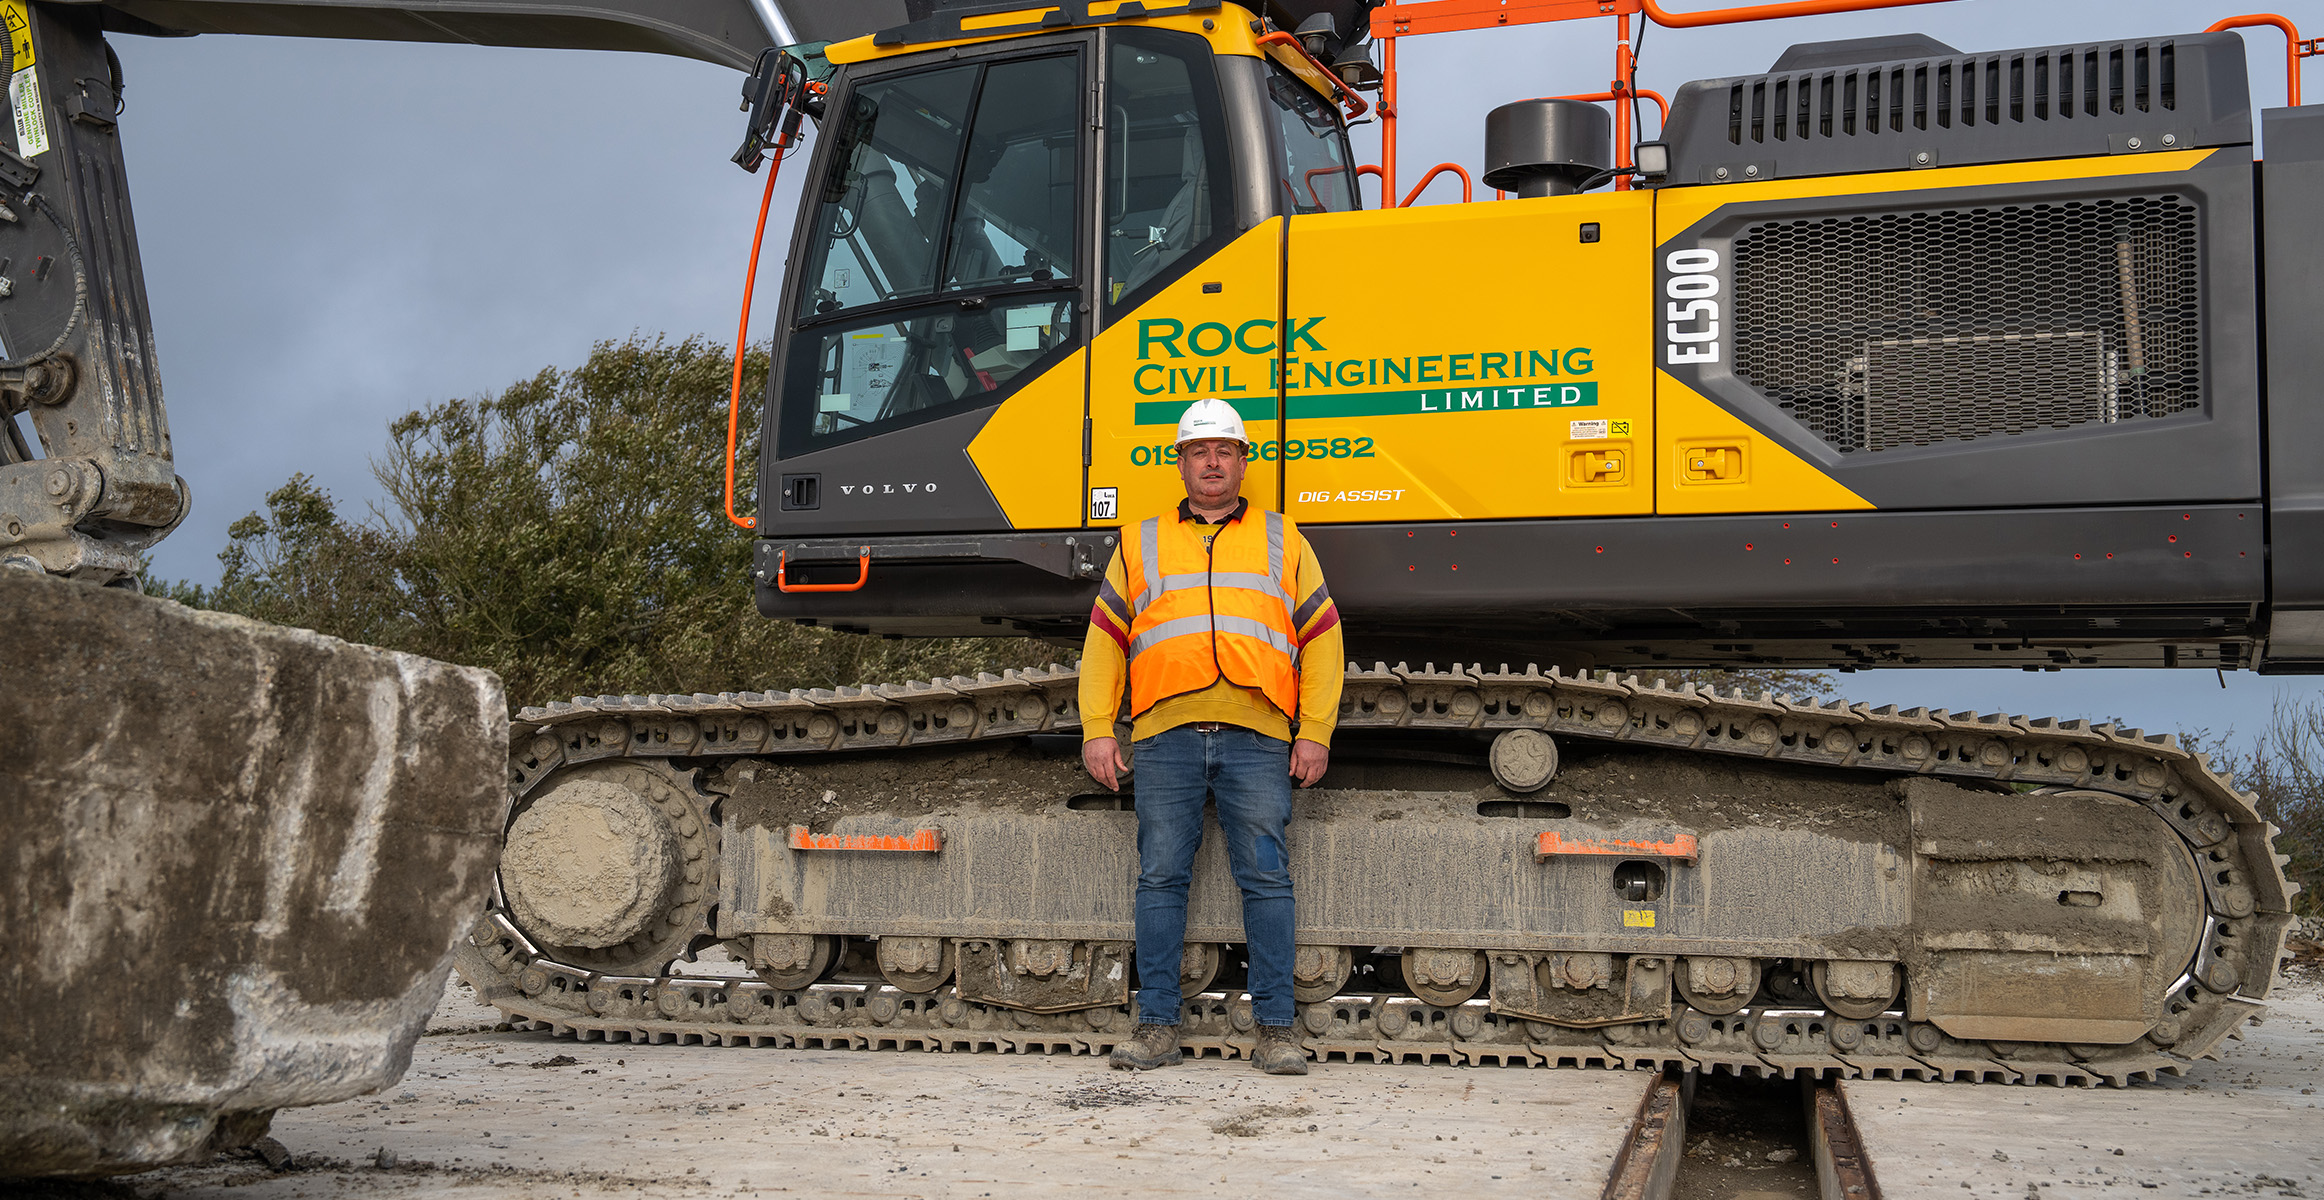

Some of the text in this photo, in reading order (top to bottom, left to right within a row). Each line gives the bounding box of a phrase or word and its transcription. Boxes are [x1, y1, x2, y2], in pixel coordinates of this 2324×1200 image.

[18, 83, 34, 145] GENUINE MILLER
[23, 73, 41, 149] TWINLOCK COUPLER
[1666, 248, 1719, 364] EC500
[1136, 316, 1328, 360] ROCK
[1133, 347, 1595, 396] CIVIL ENGINEERING
[1420, 386, 1582, 412] LIMITED
[1130, 444, 1179, 466] 019
[840, 482, 938, 496] VOLVO
[1298, 489, 1406, 503] DIG ASSIST
[1093, 501, 1110, 517] 107
